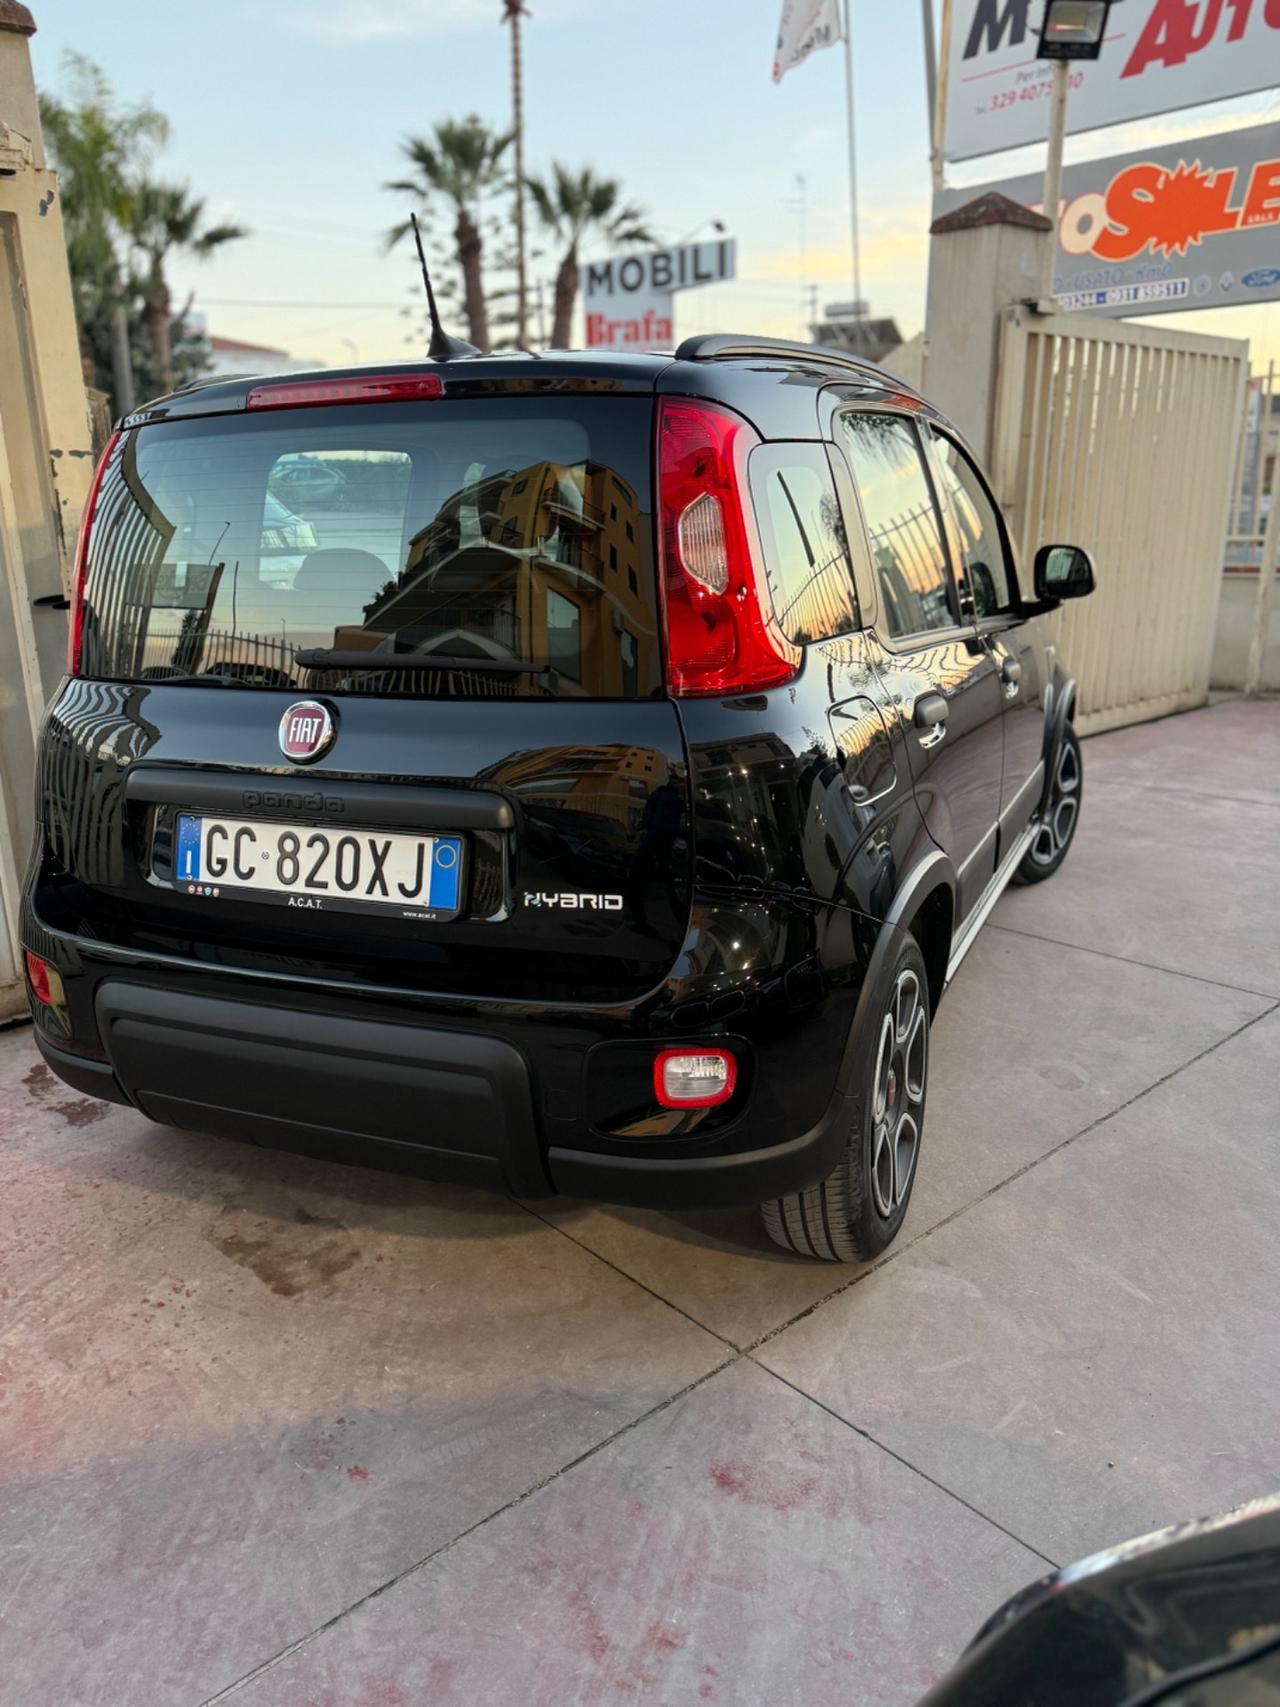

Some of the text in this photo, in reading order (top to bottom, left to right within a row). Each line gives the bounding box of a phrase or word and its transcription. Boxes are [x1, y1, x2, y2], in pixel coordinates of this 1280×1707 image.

[588, 242, 726, 296] MOBILI
[585, 308, 674, 347] Brafa
[288, 717, 323, 744] FIAT
[242, 790, 345, 813] panda
[206, 824, 257, 880] GC
[523, 891, 623, 910] HYBRID
